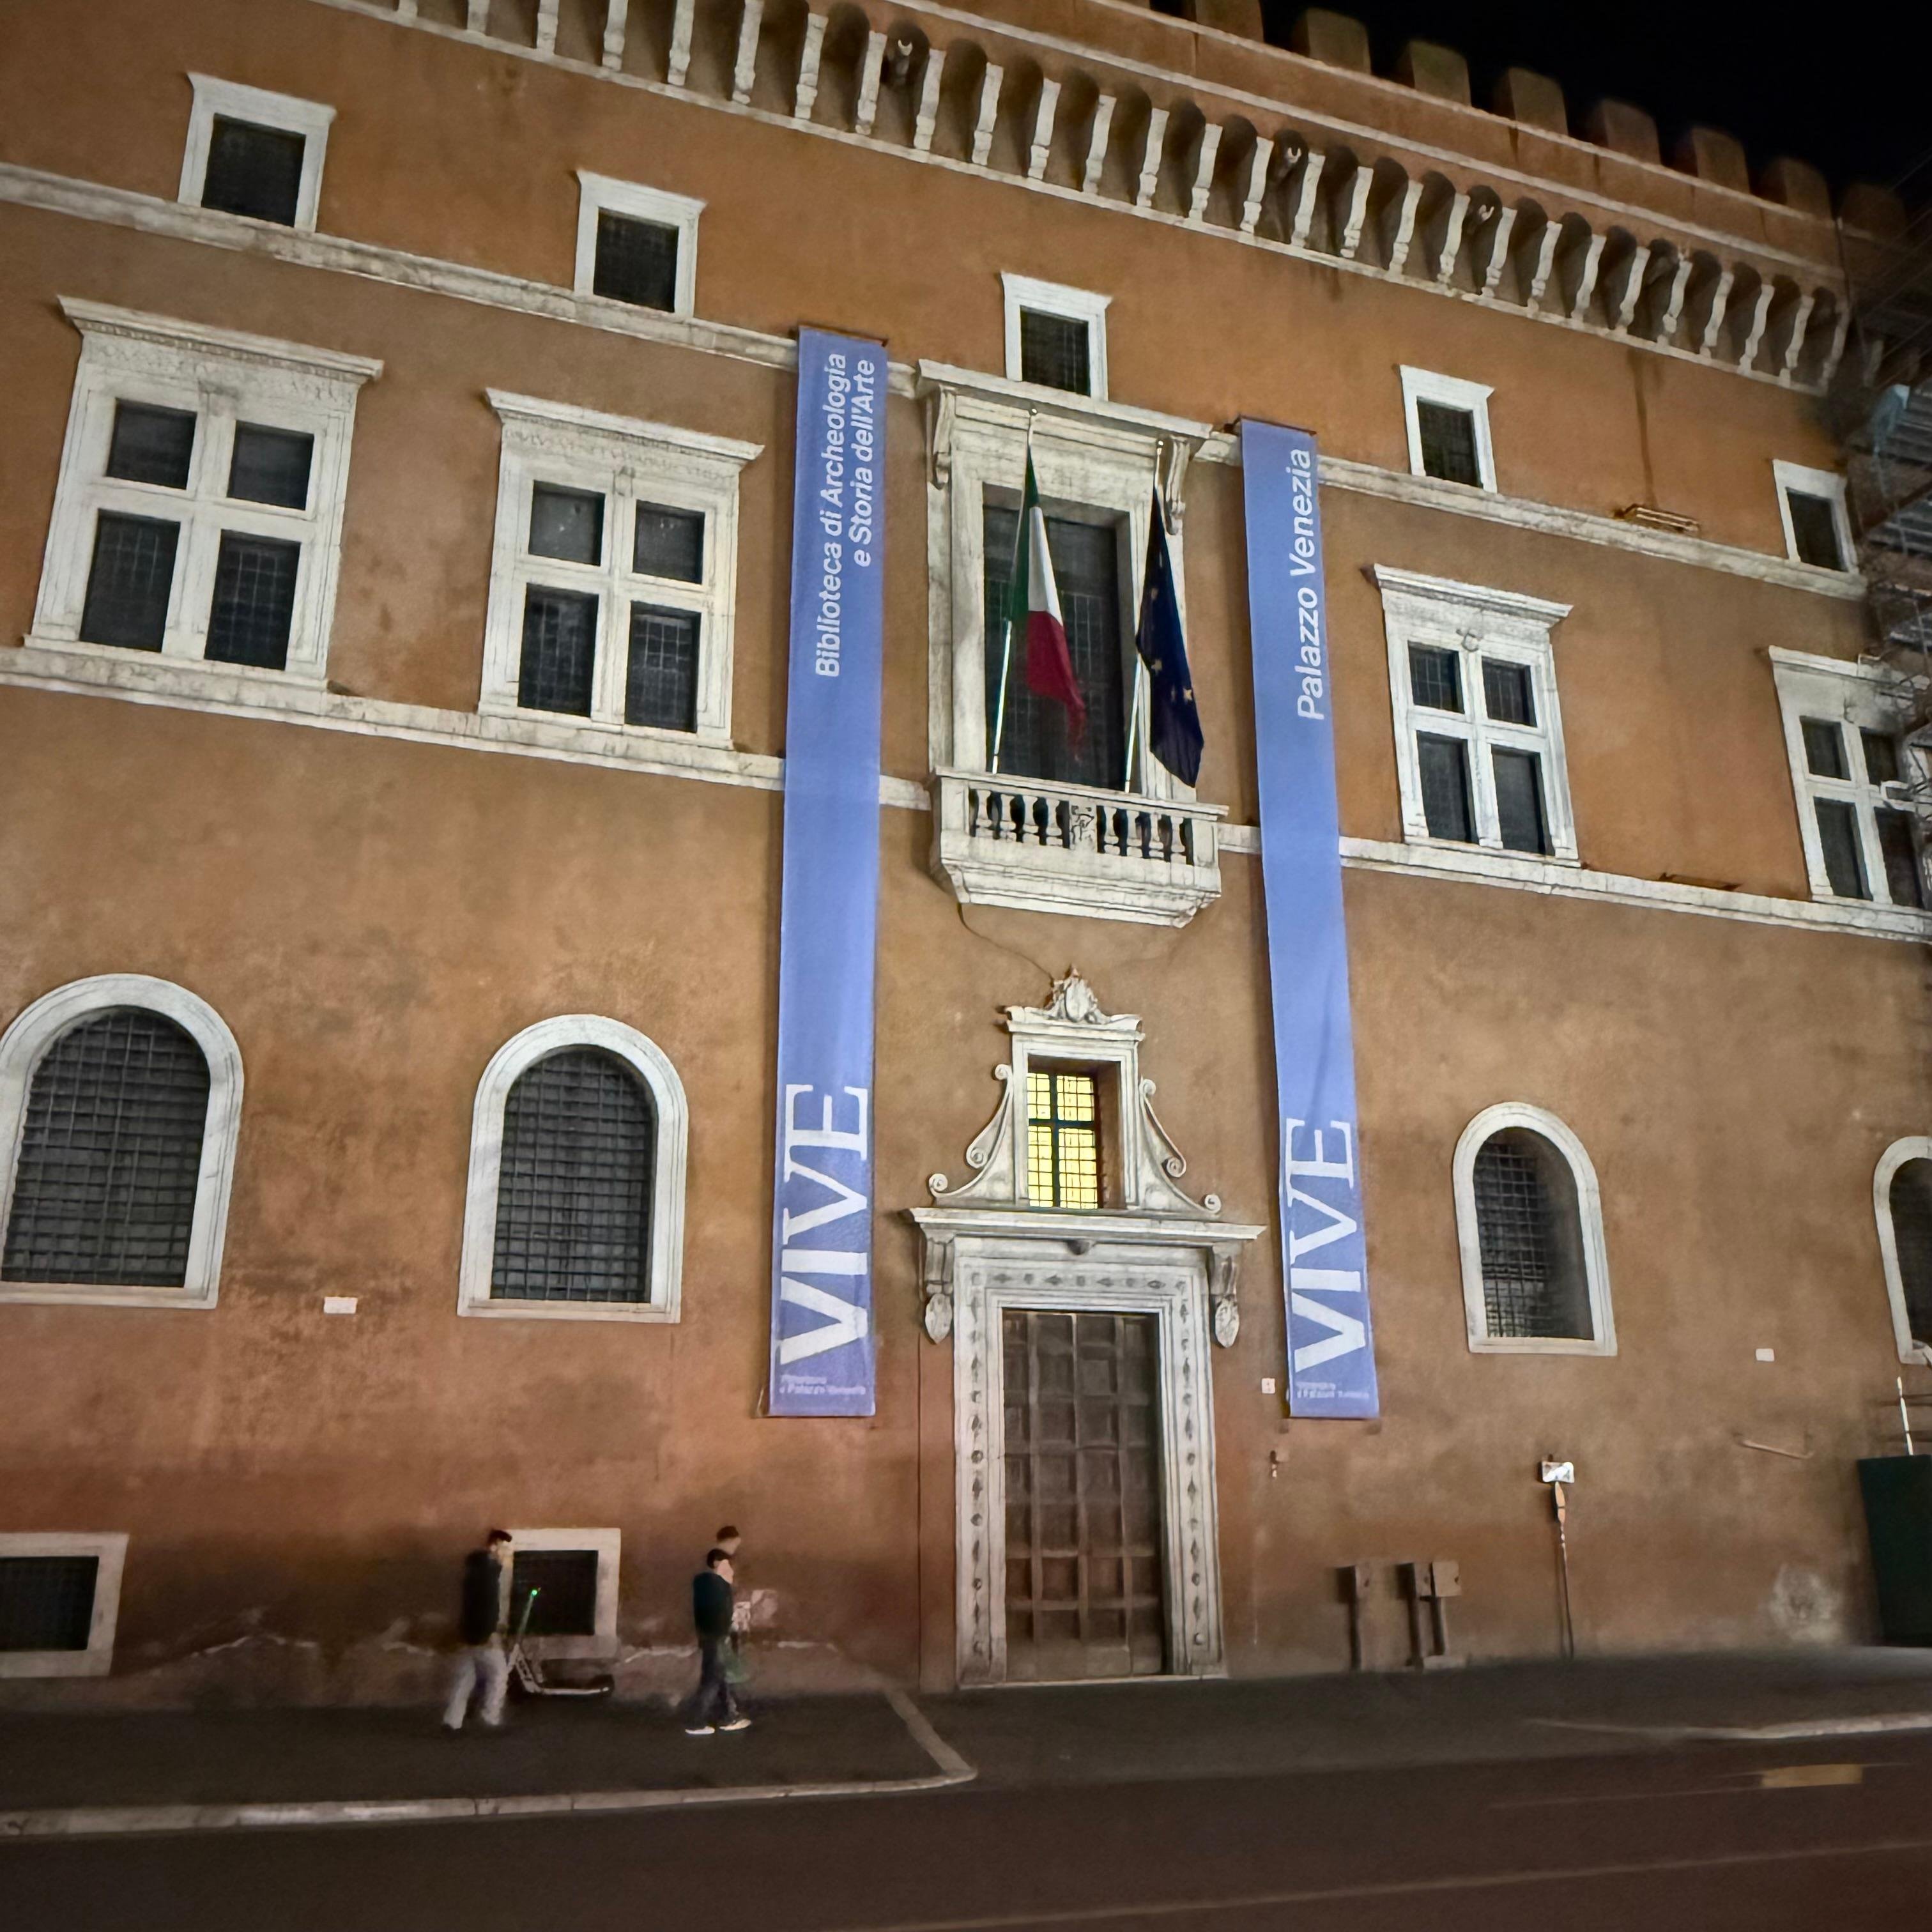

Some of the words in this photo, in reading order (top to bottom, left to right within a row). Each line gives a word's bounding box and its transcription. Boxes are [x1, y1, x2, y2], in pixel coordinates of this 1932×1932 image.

[820, 353, 850, 508] Archeologia
[851, 359, 875, 462] dell'Arte
[820, 510, 842, 536] di
[849, 467, 873, 545] Storia
[854, 549, 871, 567] e
[1285, 448, 1315, 576] Venezia
[816, 542, 842, 677] Biblioteca
[1295, 587, 1324, 720] Palazzo
[781, 1084, 868, 1365] VIVE
[1285, 1118, 1366, 1372] VIVE
